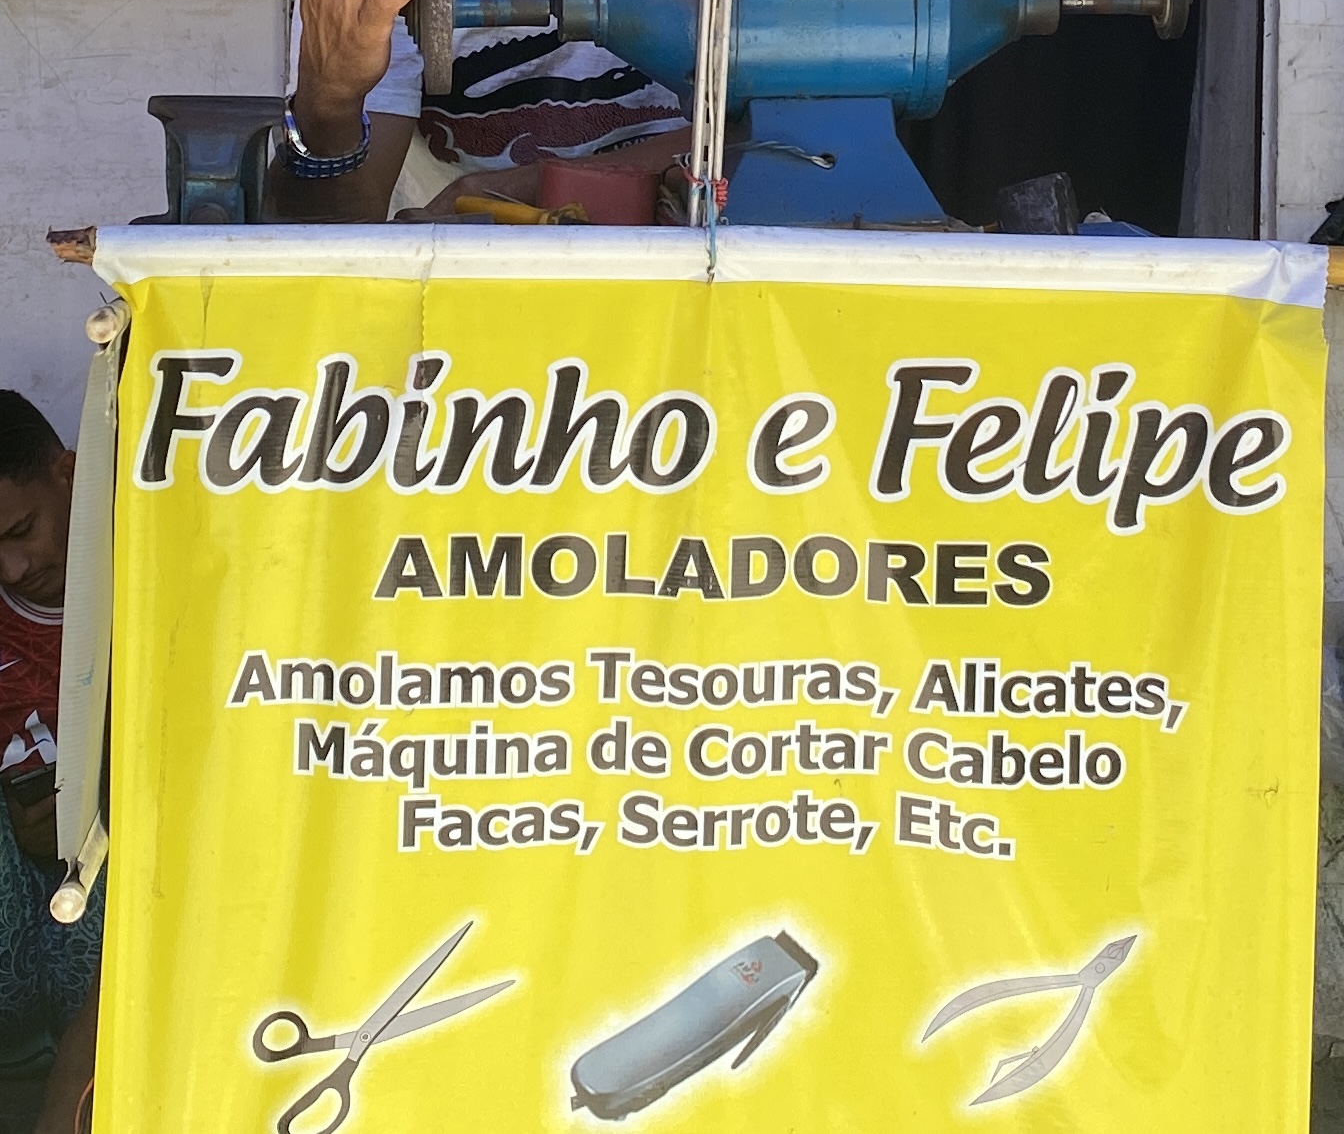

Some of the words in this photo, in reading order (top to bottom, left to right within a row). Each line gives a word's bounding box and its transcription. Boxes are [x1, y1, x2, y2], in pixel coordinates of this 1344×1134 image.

[140, 356, 710, 488] Fabinho
[753, 393, 829, 488] e
[877, 366, 1285, 528] Felipe
[374, 534, 1051, 607] AMOLADORES
[231, 654, 572, 706] Amolamos
[589, 651, 897, 713] Tesouras,
[915, 662, 1184, 728] Alicates,
[295, 722, 569, 789] Máquina
[590, 721, 668, 774] de
[688, 728, 888, 777] Cortar
[907, 733, 1123, 786] Cabelo
[402, 797, 600, 851] Facas,
[619, 795, 875, 850] Serrote,
[899, 797, 1013, 857] Etc.
